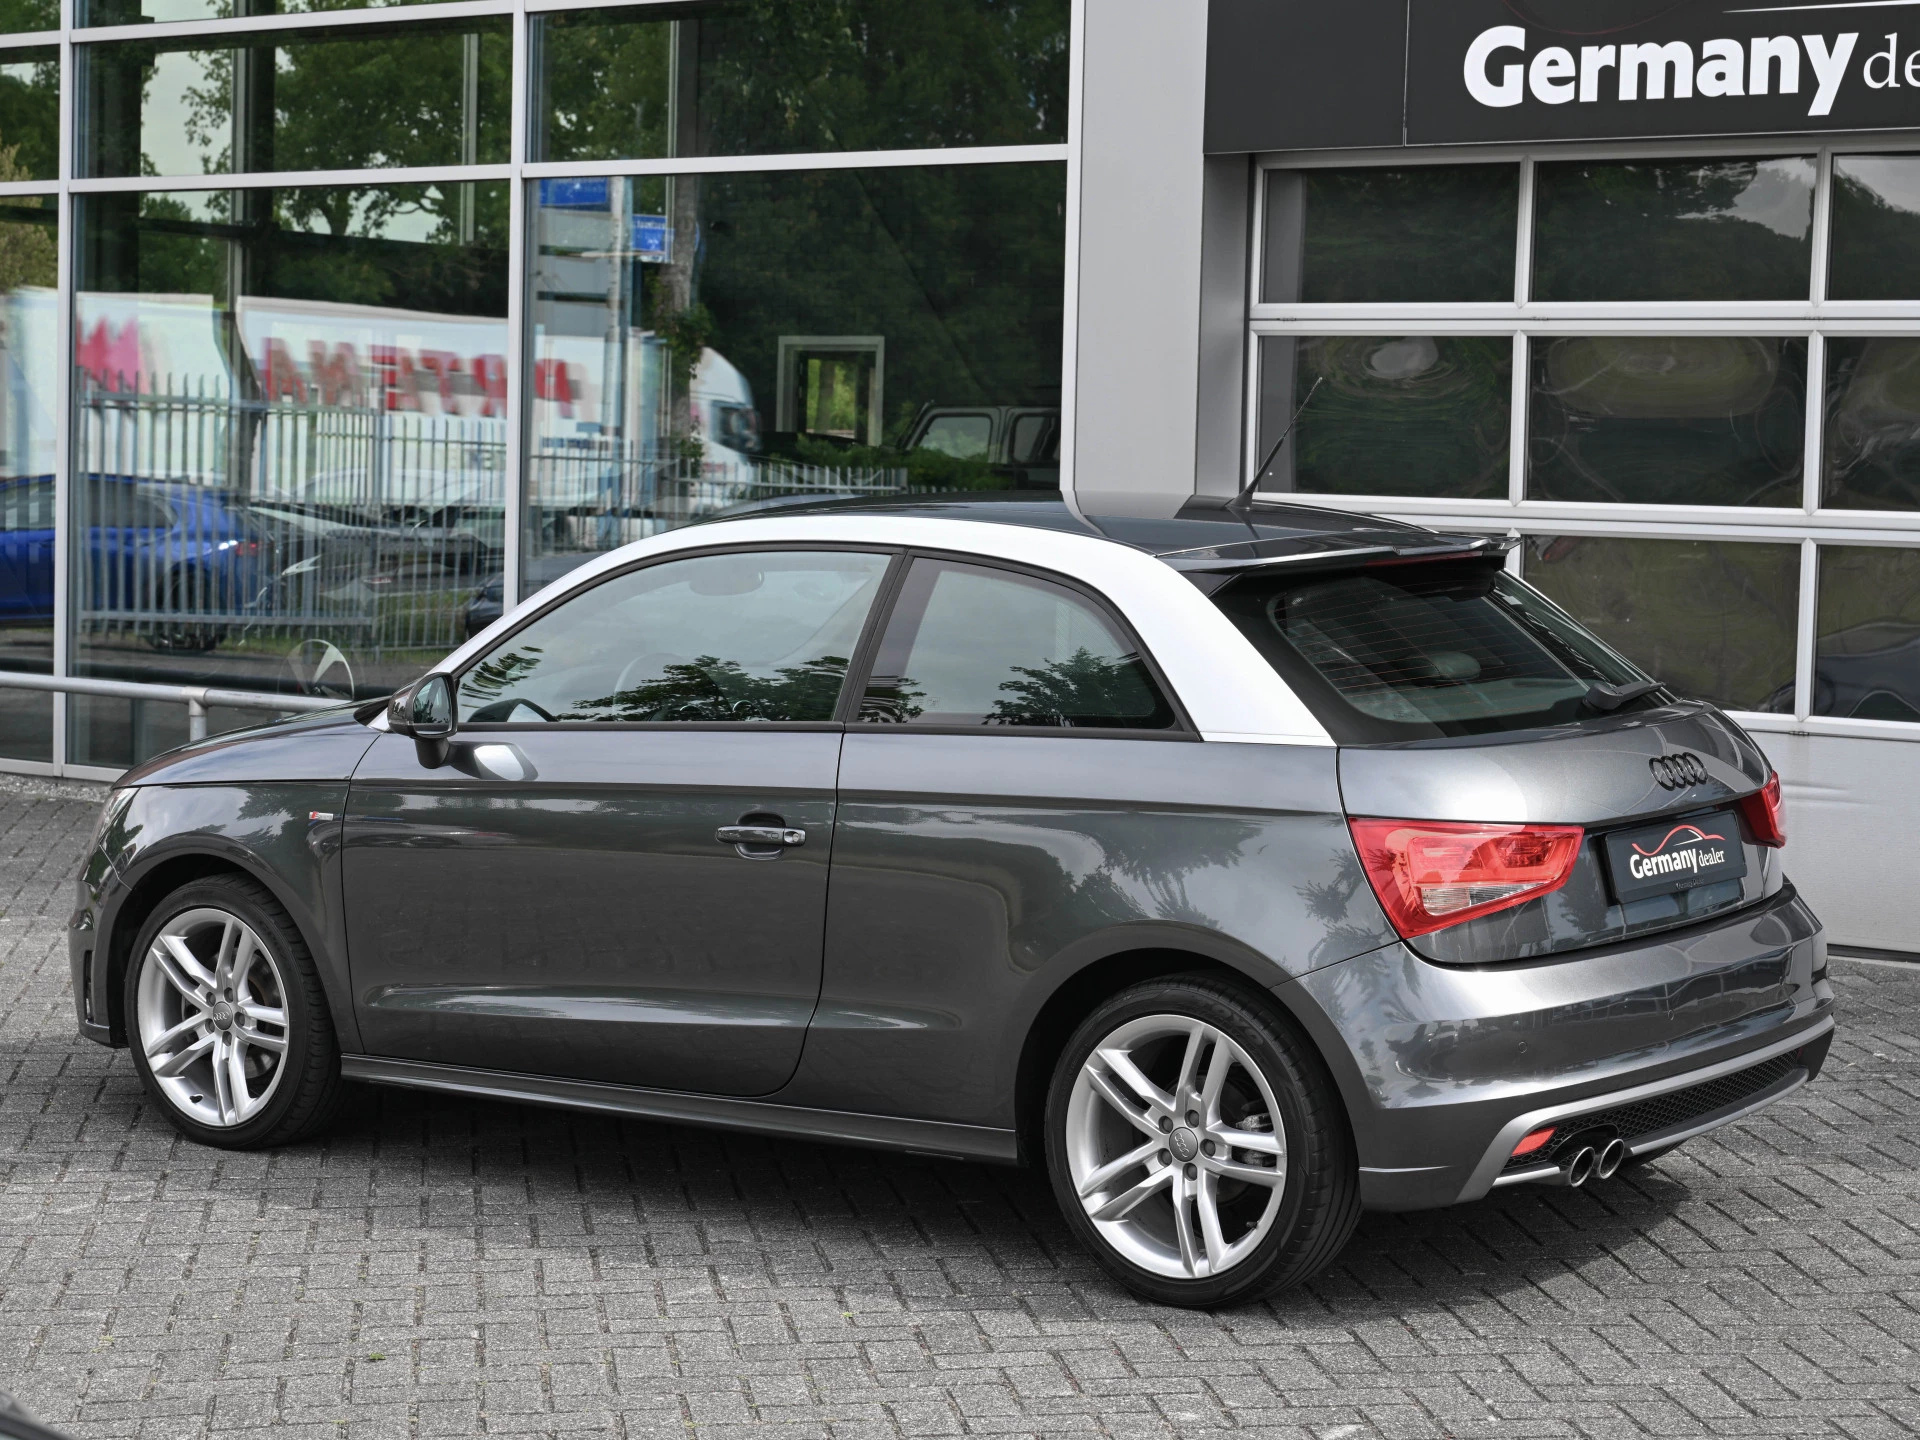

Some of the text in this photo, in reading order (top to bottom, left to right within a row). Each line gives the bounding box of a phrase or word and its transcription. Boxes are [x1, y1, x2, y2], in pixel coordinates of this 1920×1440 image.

[1463, 25, 1860, 117] Germany
[1630, 847, 1726, 879] Germany dealer
